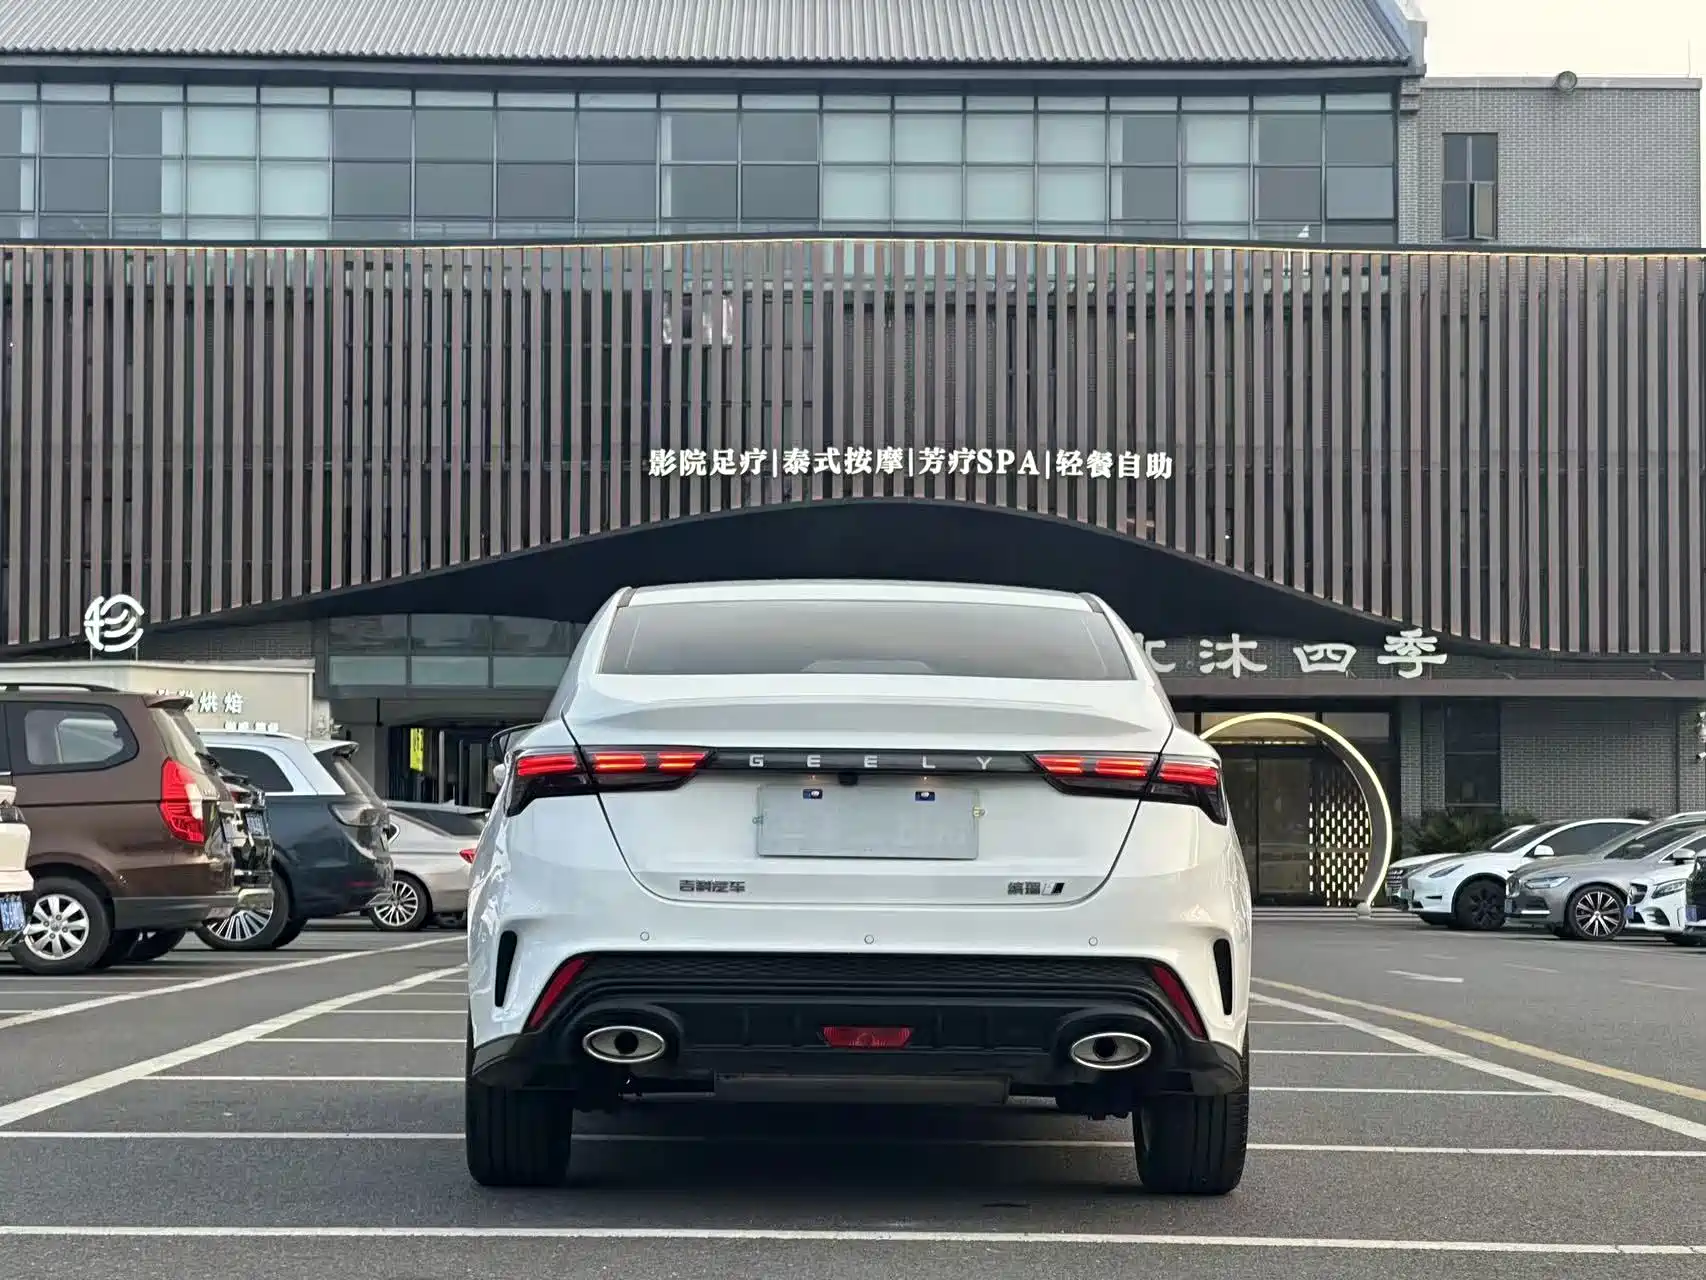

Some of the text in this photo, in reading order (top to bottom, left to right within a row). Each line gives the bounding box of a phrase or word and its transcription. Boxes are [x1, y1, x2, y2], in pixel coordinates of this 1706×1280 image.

[749, 754, 992, 770] GEELY
[680, 880, 745, 893] 吉利汽车
